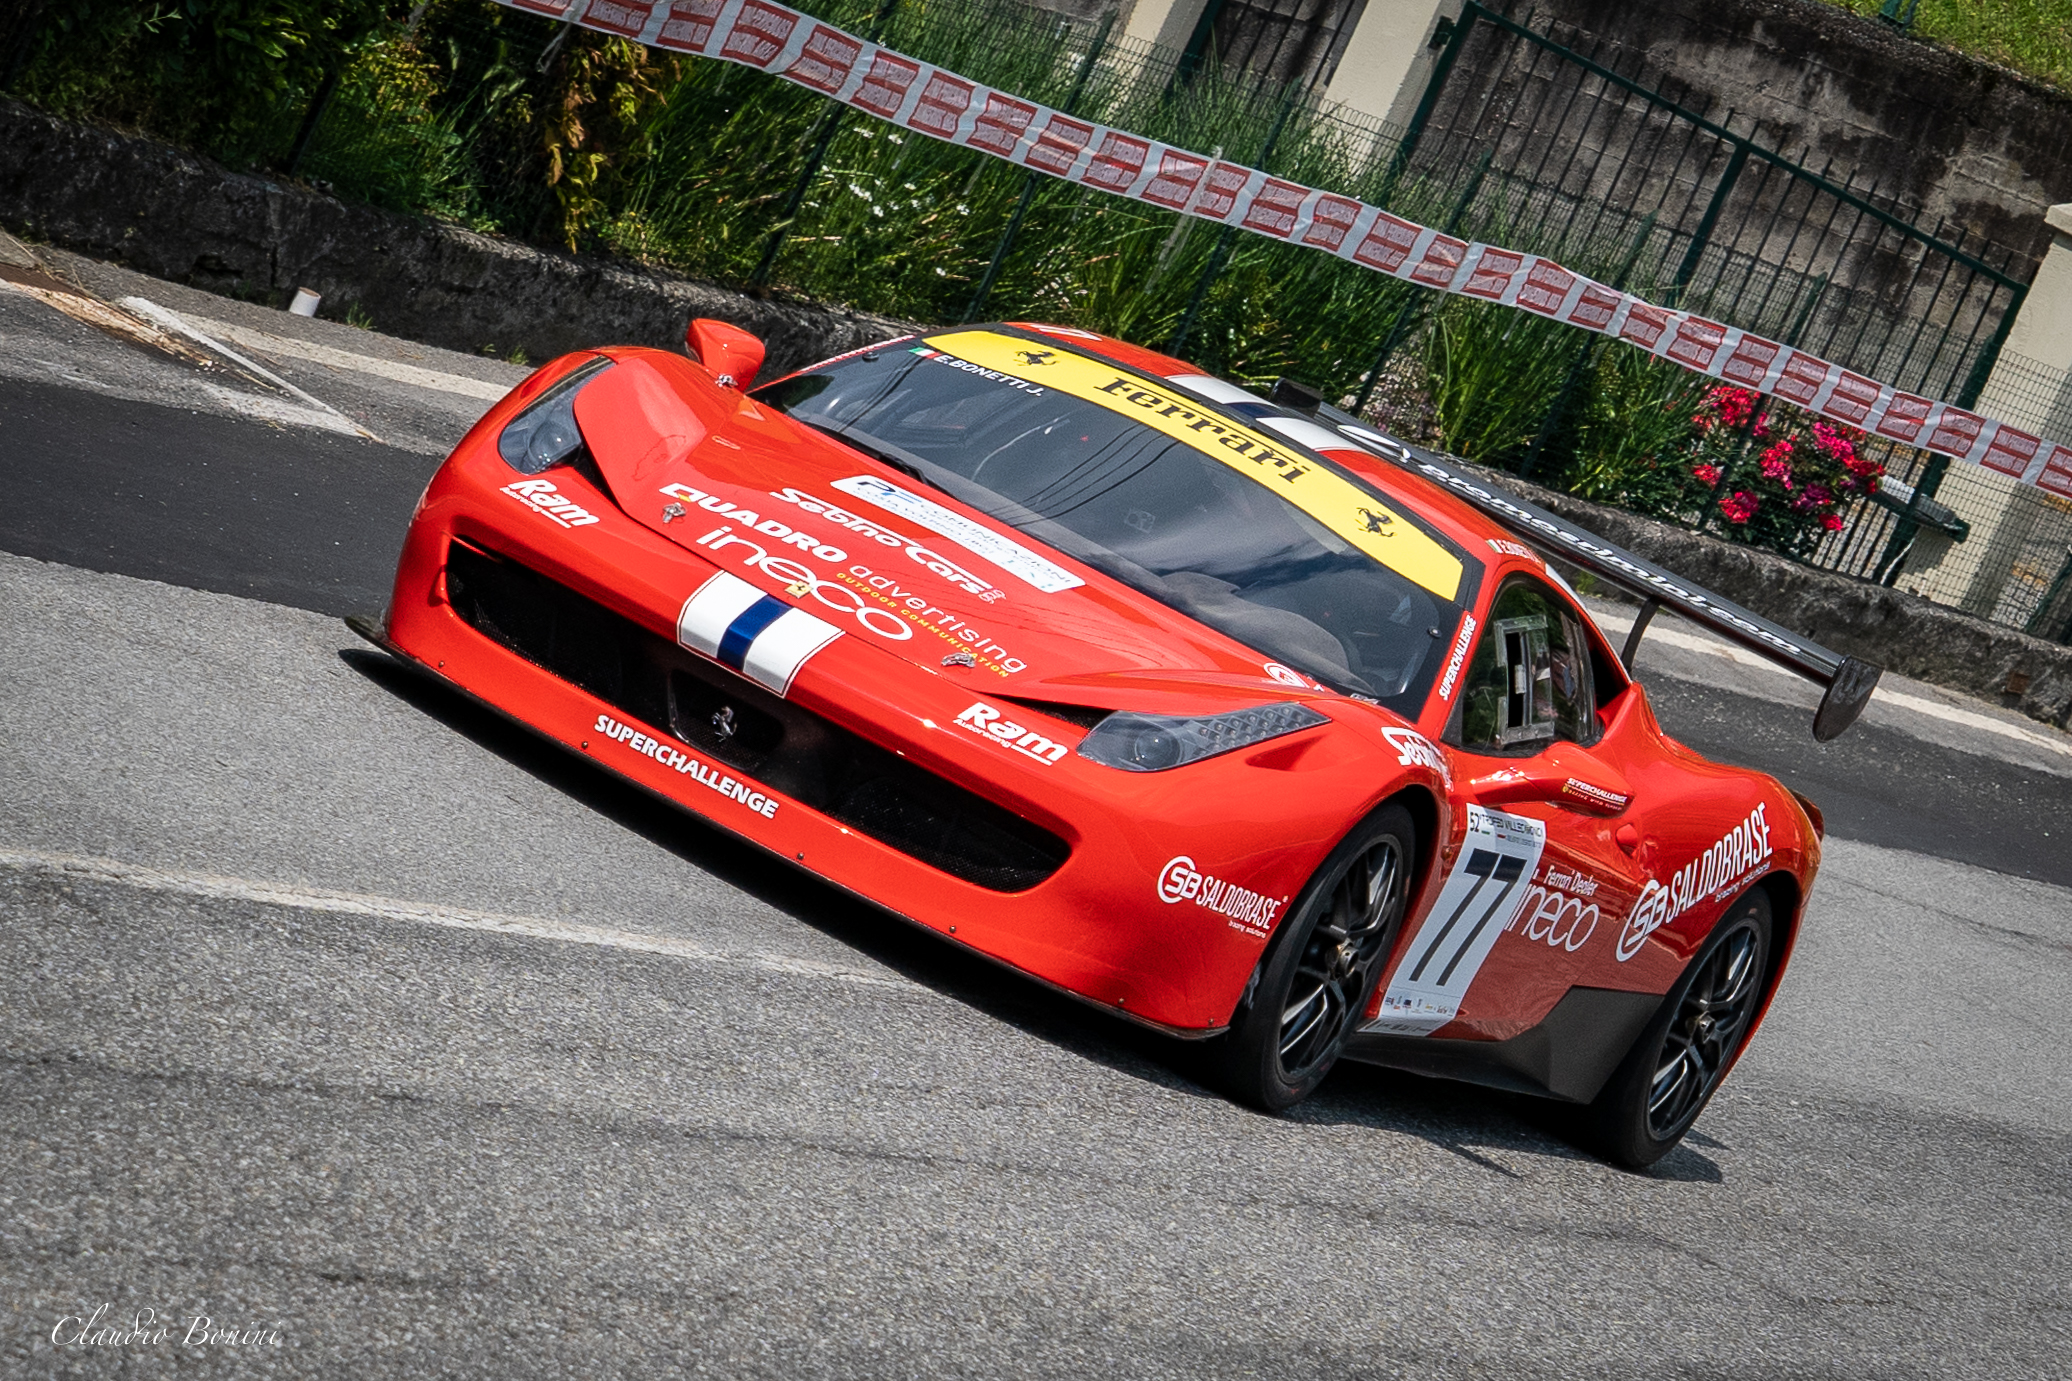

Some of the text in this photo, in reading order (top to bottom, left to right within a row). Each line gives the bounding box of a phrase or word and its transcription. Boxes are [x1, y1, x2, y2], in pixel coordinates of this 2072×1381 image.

[933, 355, 1030, 390] E.BONETTI
[1093, 377, 1311, 484] Ferrari
[507, 479, 600, 526] Ram
[658, 482, 848, 563] QUADRO
[696, 525, 914, 641] ineco
[904, 544, 994, 596] Cars
[836, 572, 1010, 678] OUTDOOR COMMUNICATION
[848, 564, 1028, 674] advertising
[1438, 613, 1477, 702] SUPERCHALLENGE
[593, 714, 780, 820] SUPERCHALLENGE
[956, 701, 1068, 762] Ram
[1195, 874, 1282, 930] SALDOBRASE
[1665, 801, 1774, 924] SALDOBRASE
[1408, 847, 1528, 987] 77
